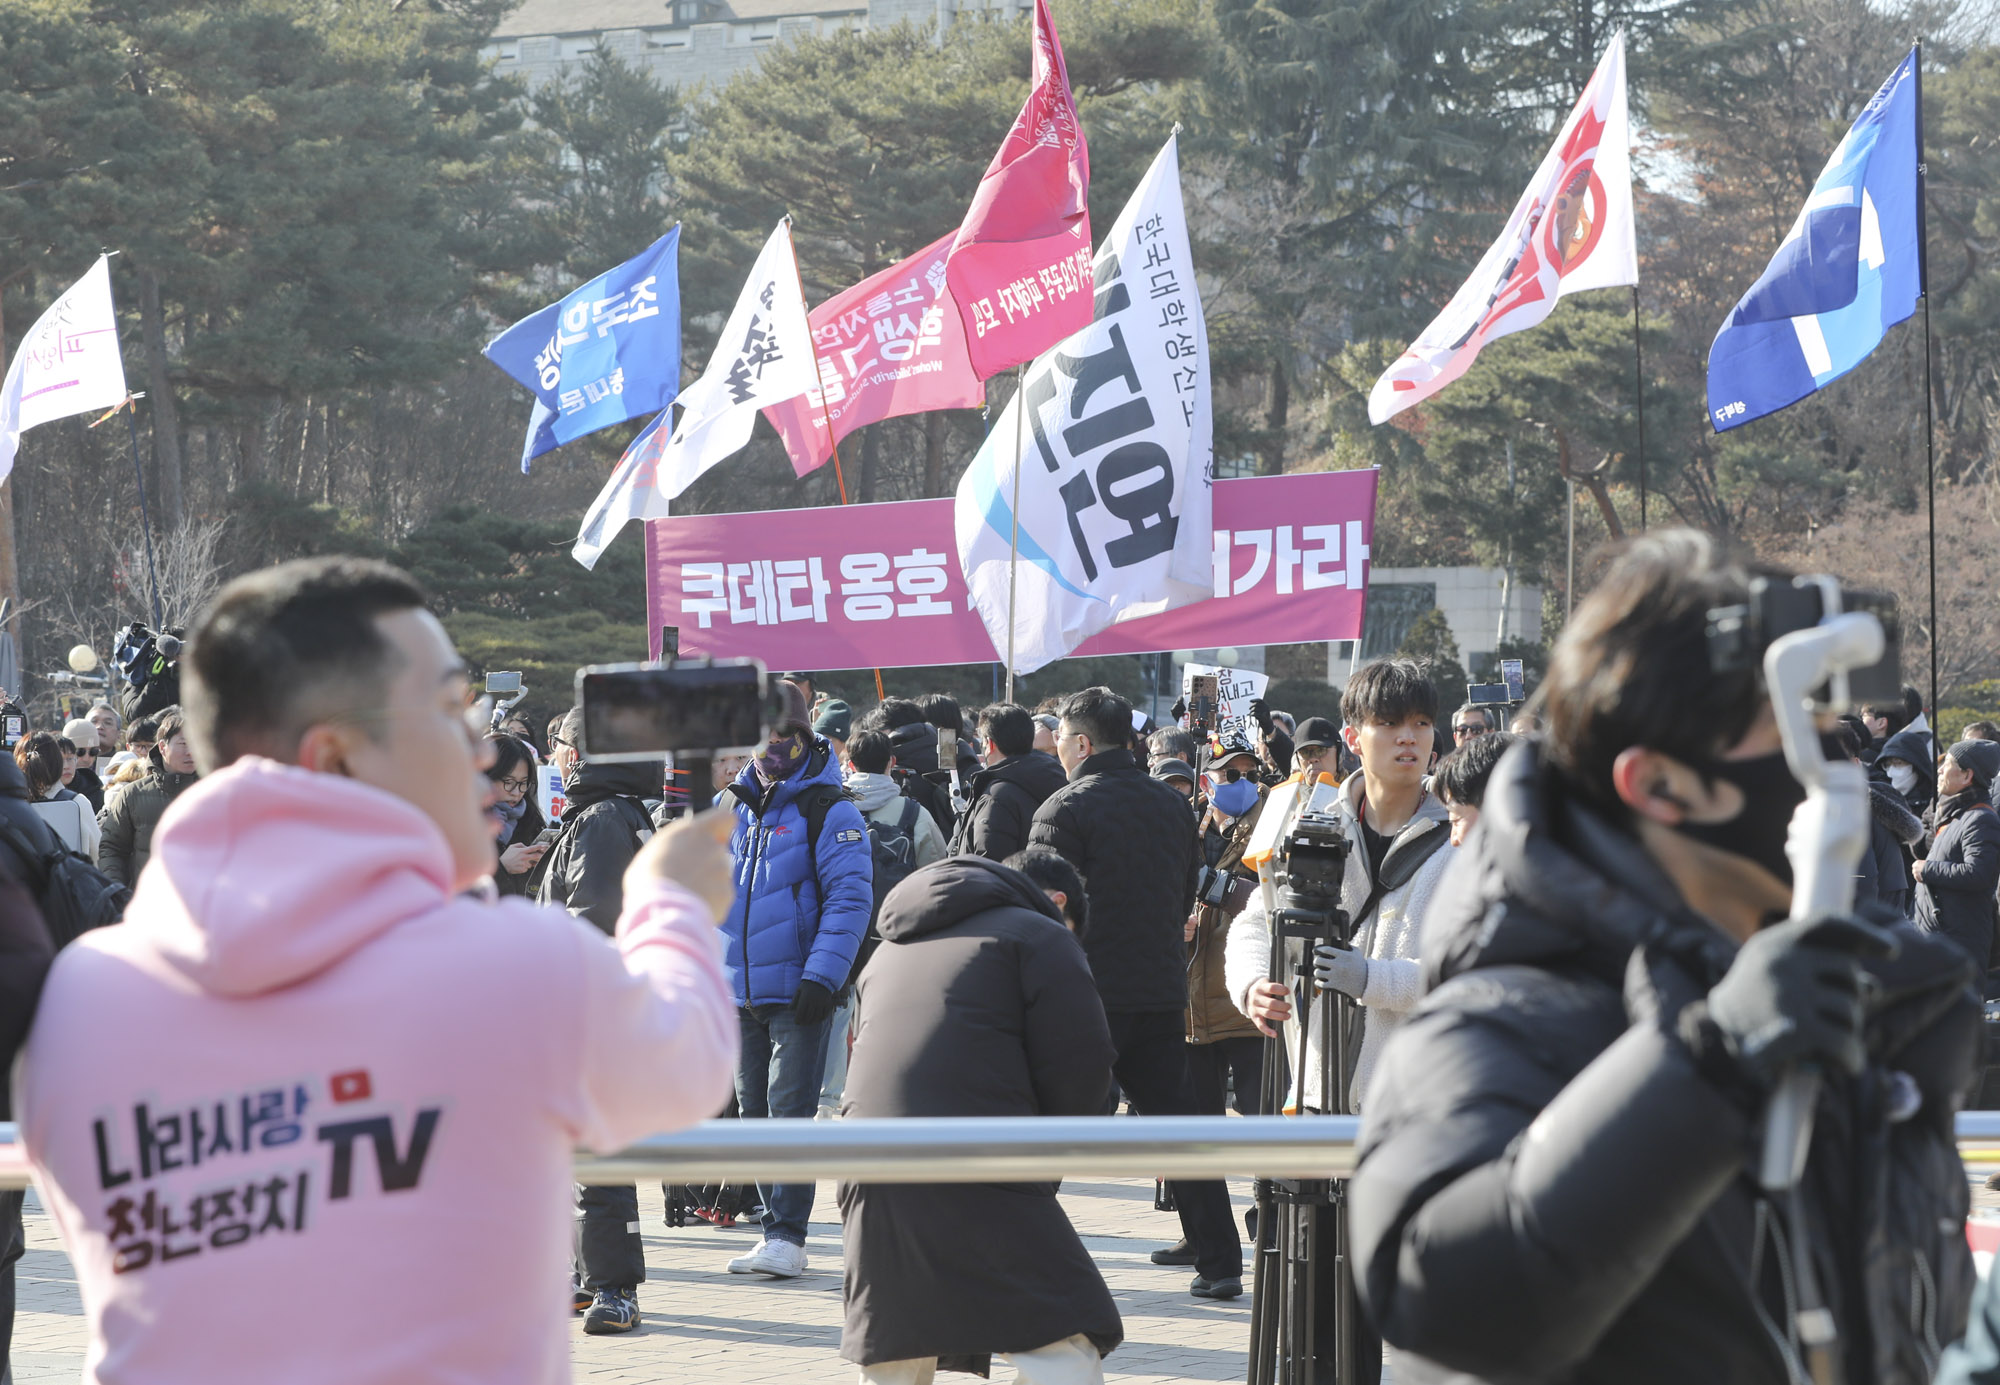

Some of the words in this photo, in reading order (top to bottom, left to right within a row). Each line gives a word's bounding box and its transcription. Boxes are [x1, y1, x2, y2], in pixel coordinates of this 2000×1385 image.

[681, 556, 832, 629] 쿠데타
[839, 548, 953, 622] 옹호
[93, 1085, 309, 1190] 나라사랑
[318, 1107, 442, 1201] TV
[106, 1170, 309, 1276] 청년정치
